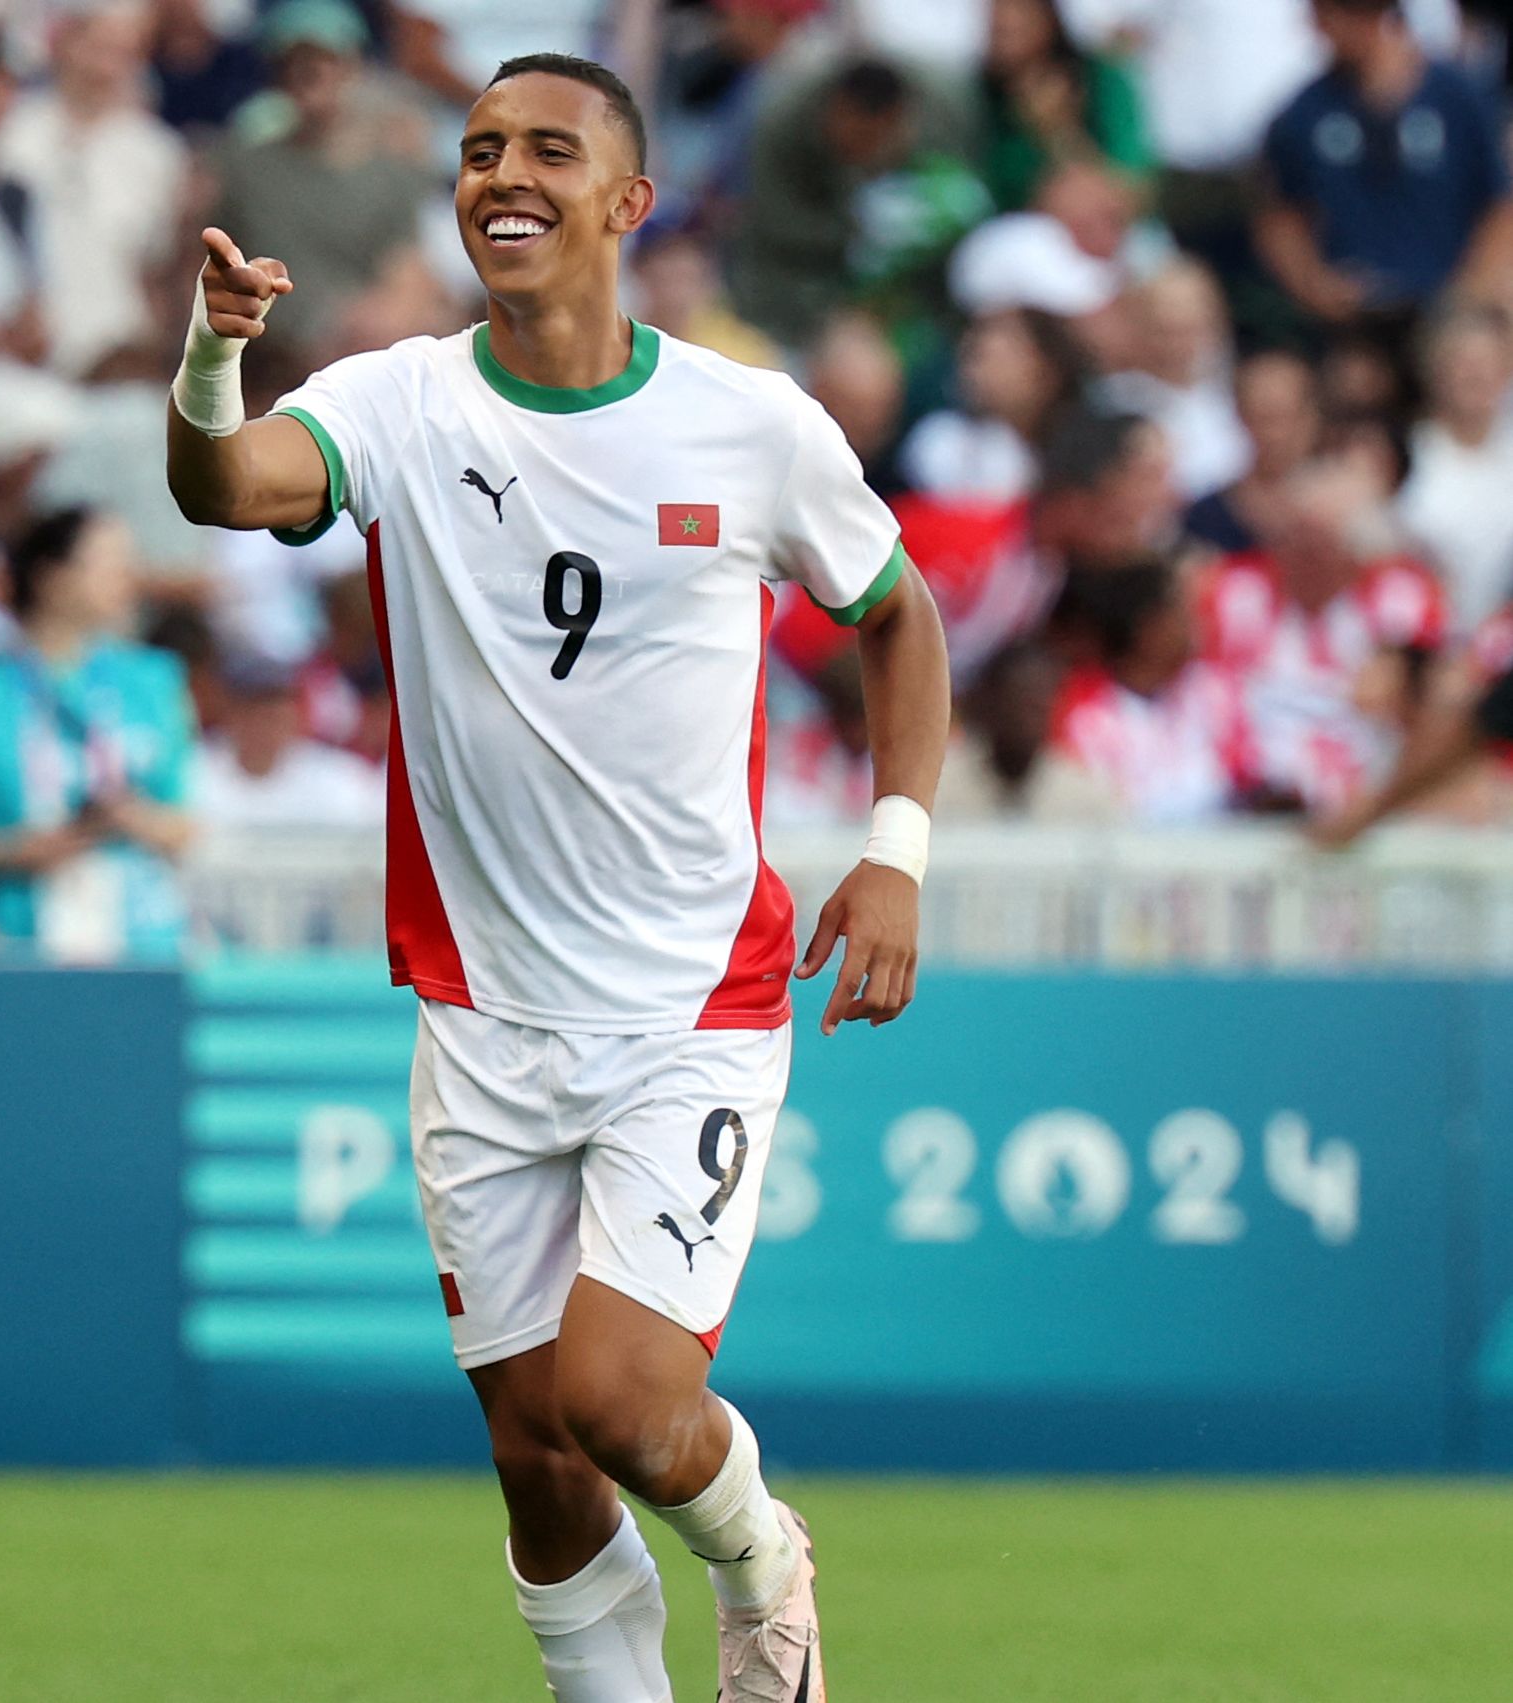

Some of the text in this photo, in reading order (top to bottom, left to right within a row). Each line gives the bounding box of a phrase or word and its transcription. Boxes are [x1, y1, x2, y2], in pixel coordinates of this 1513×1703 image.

[470, 571, 631, 599] CATAT
[543, 551, 602, 680] 9
[698, 1107, 748, 1226] 9
[881, 1107, 1362, 1246] 2024
